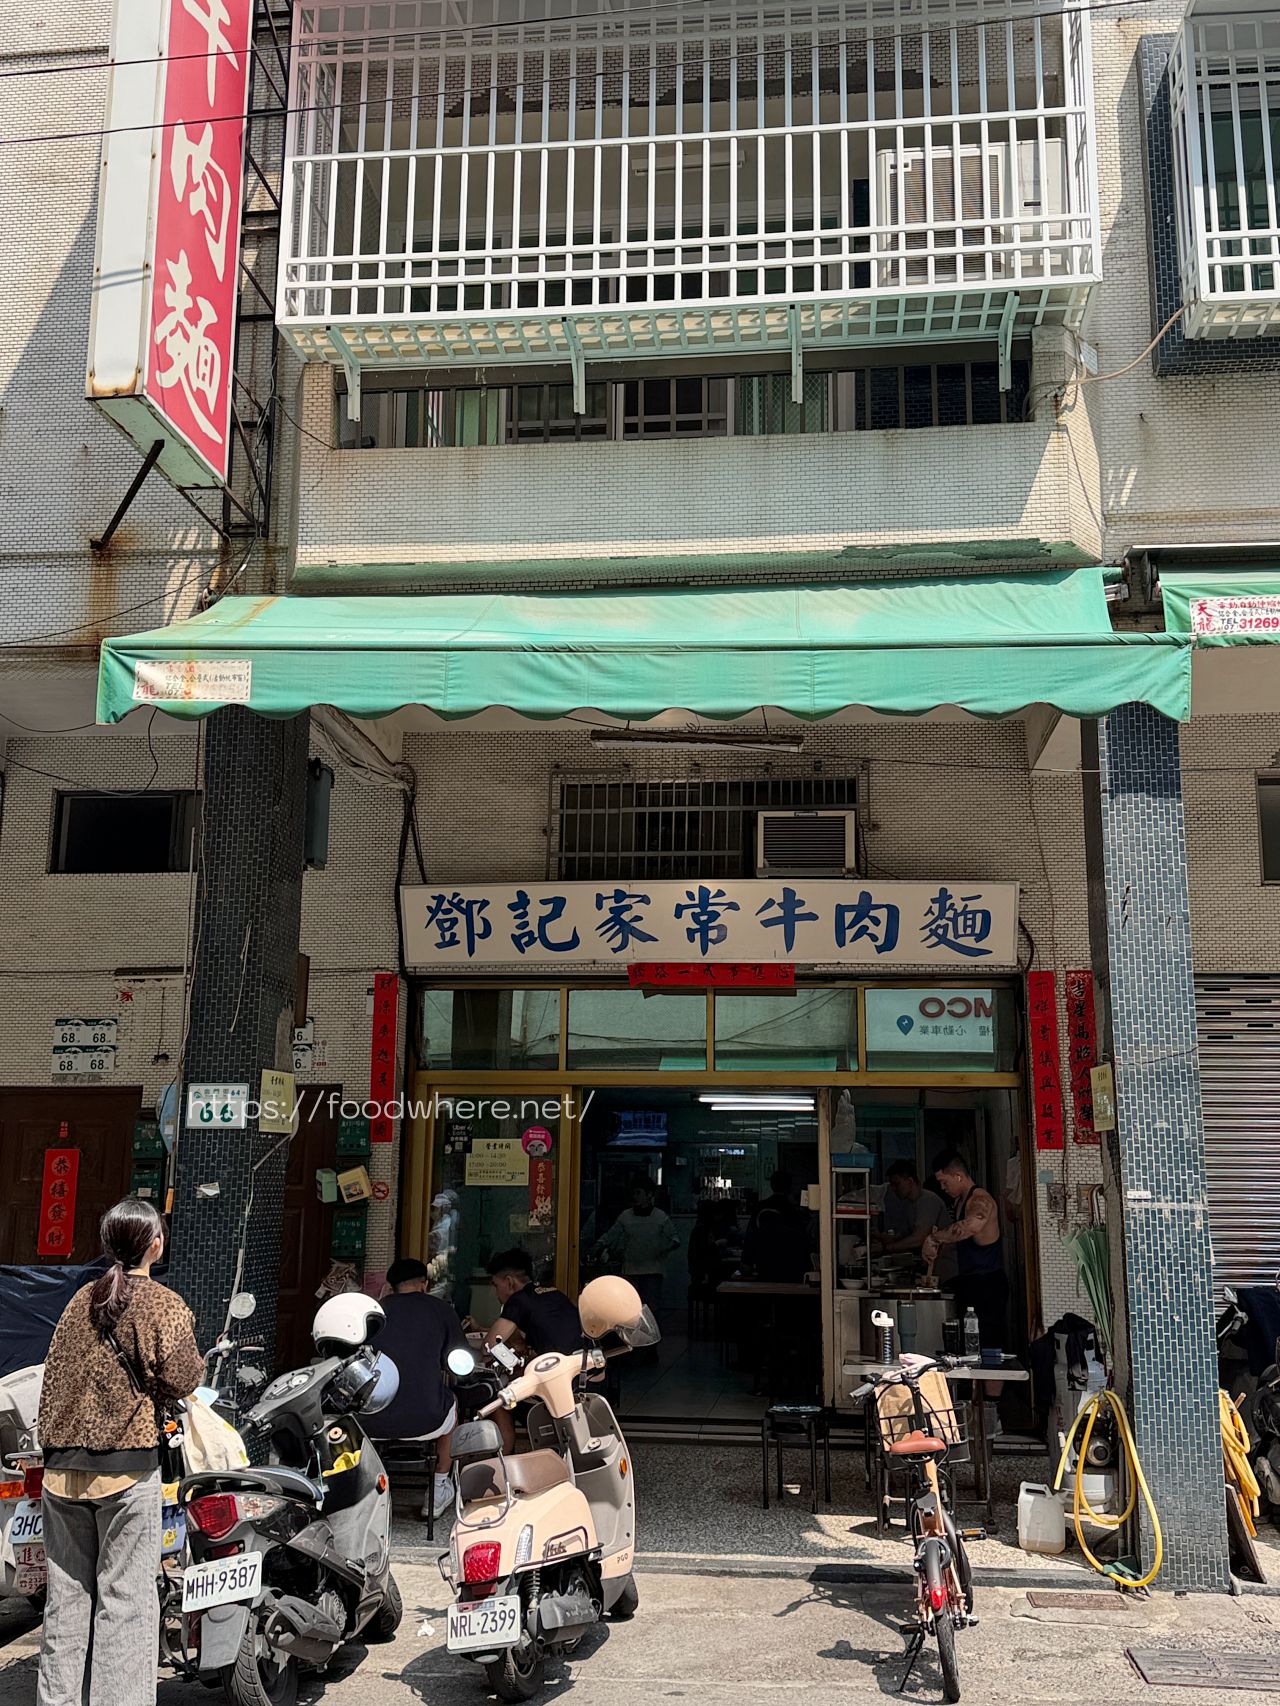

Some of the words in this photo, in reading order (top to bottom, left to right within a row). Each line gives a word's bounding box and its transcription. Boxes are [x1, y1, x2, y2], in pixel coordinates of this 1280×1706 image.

[1239, 617, 1280, 629] 31269
[425, 884, 994, 957] 鄧記家常牛肉麵
[61, 1032, 75, 1043] 68
[92, 1032, 106, 1043] 68
[59, 1060, 73, 1071] 68
[90, 1059, 104, 1070] 68
[199, 1101, 234, 1123] 66
